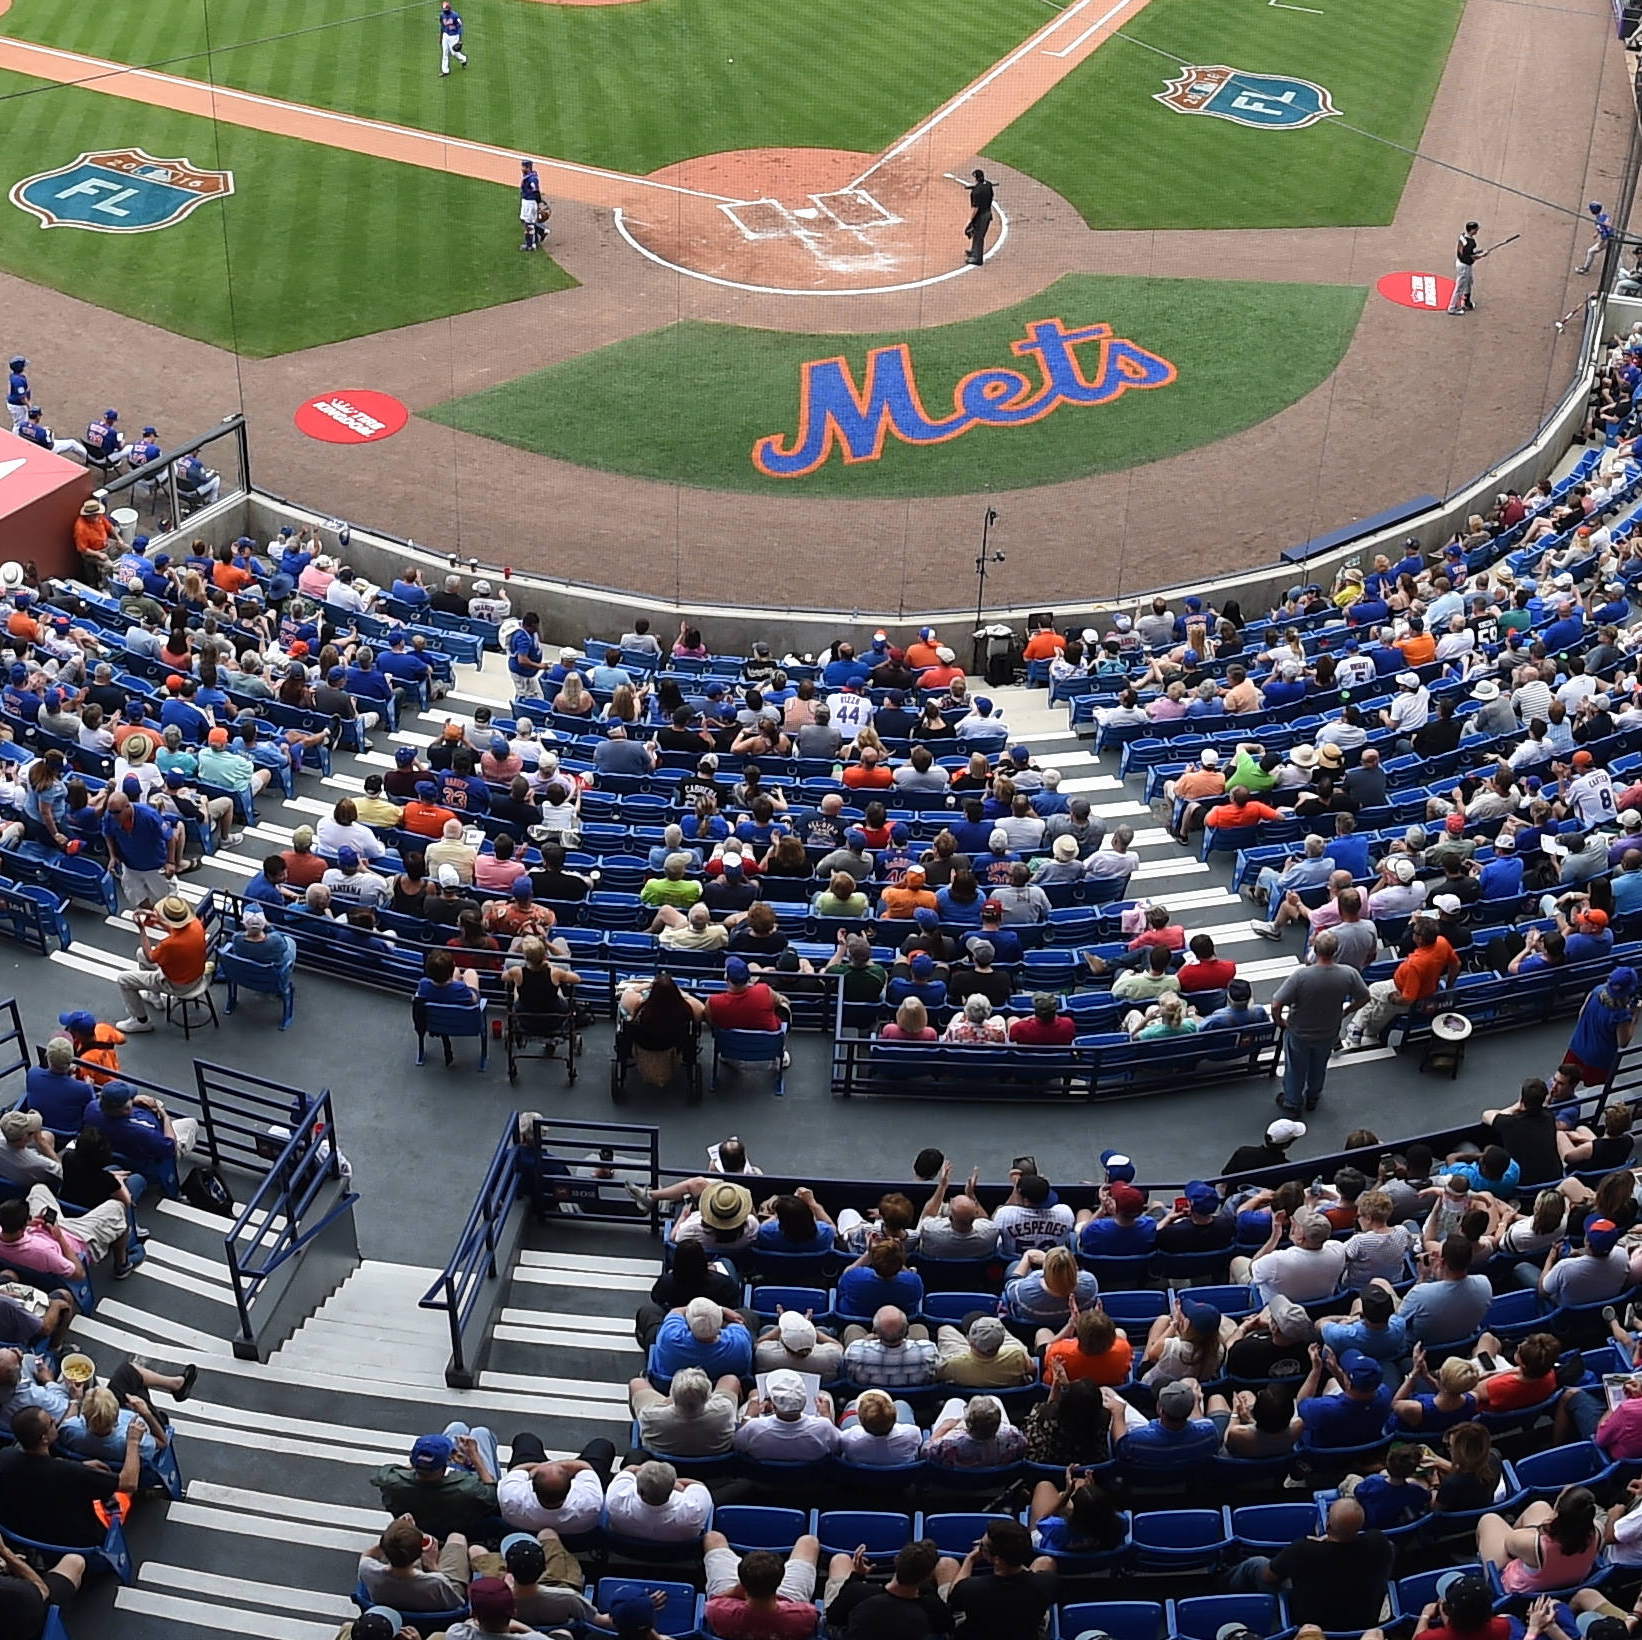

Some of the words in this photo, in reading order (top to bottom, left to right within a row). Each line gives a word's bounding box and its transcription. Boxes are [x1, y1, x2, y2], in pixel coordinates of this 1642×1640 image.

[1231, 91, 1296, 116] FL
[54, 177, 140, 217] FL
[753, 316, 1177, 477] Mets
[312, 401, 376, 438] KINGDOM
[1355, 671, 1365, 682] 5
[837, 705, 860, 724] 44
[444, 777, 469, 790] HARVEY
[442, 788, 468, 809] 33
[1600, 790, 1612, 809] 8
[8, 902, 24, 912] 104
[1438, 999, 1454, 1009] 101
[1254, 1032, 1273, 1043] 102
[571, 1189, 597, 1200] 202
[1007, 1220, 1068, 1239] CESPEDES
